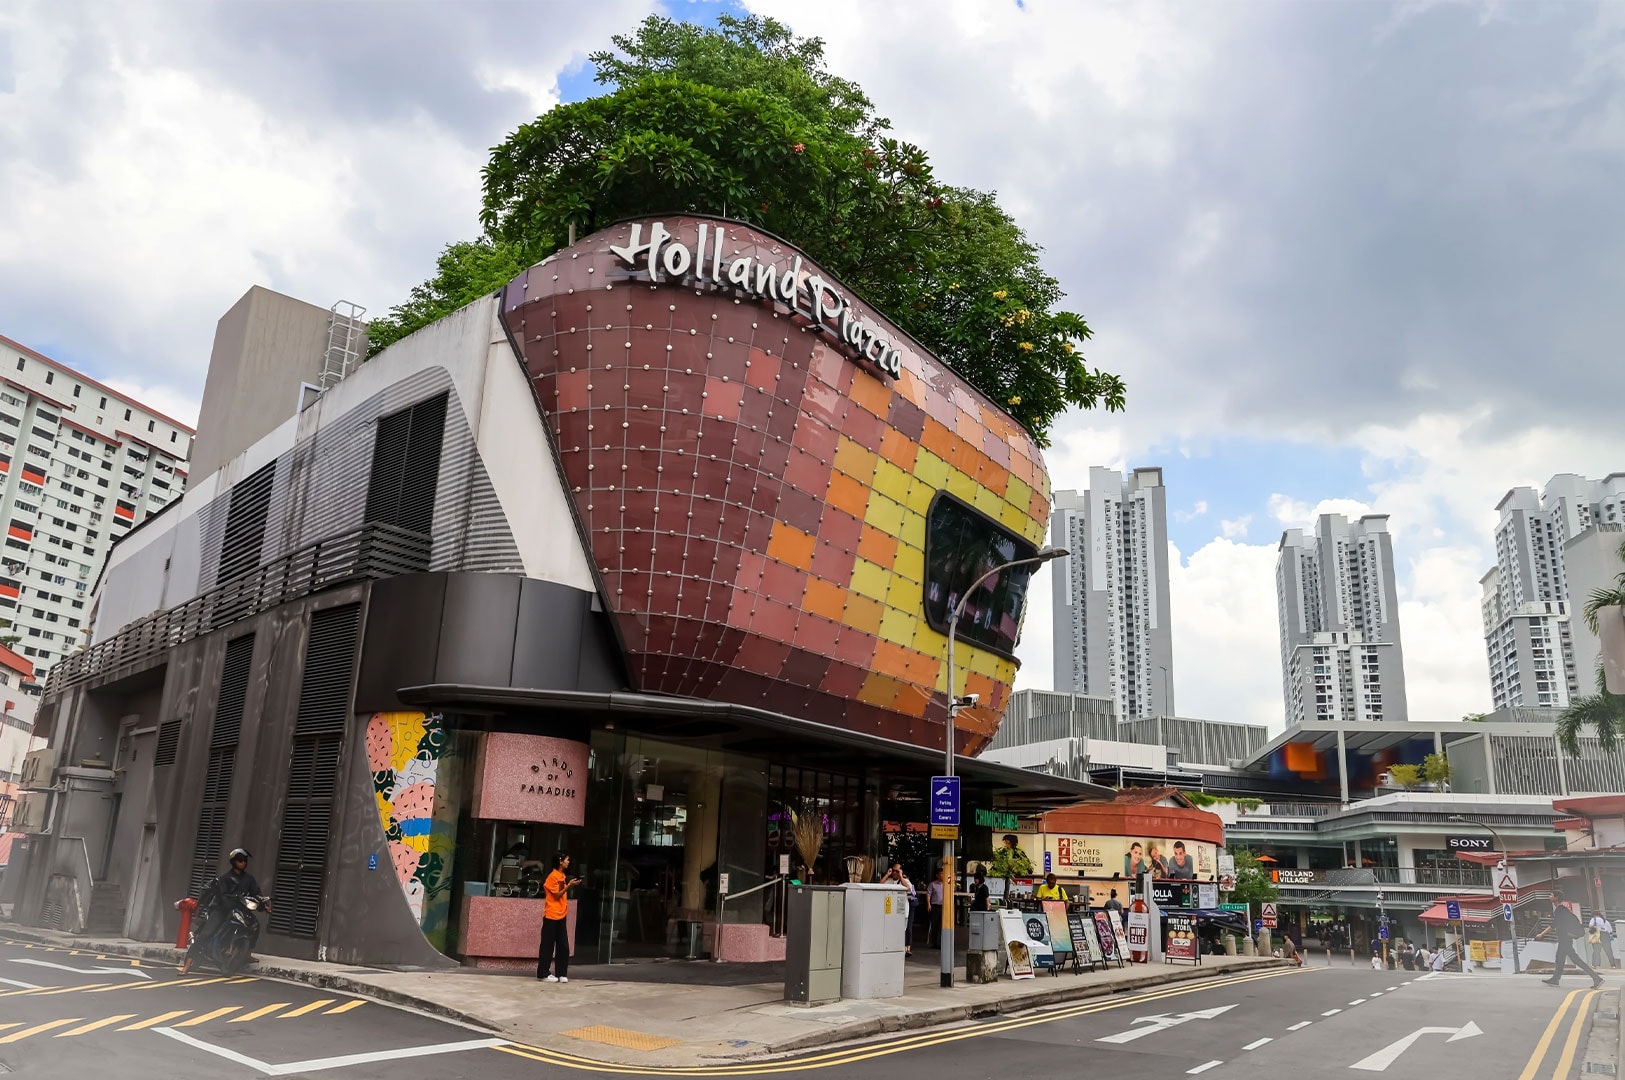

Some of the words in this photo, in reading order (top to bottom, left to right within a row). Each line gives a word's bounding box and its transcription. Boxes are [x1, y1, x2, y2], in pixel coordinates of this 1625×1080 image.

[609, 222, 803, 310] Holland
[804, 274, 902, 380] Piazza
[530, 757, 573, 779] BIRDS
[547, 773, 559, 781] OF
[520, 783, 576, 799] PARADISE
[975, 808, 1019, 831] CHIMICHANGA
[1071, 838, 1087, 847] Pet
[1449, 838, 1490, 848] SONY
[1071, 847, 1101, 855] Lovers
[1071, 854, 1101, 863] Centre
[1278, 869, 1314, 878] HOLLAND
[1279, 876, 1309, 884] VILLAGE
[1500, 893, 1517, 901] SLOW
[1130, 927, 1145, 936] WINE
[1130, 935, 1145, 944] SALE
